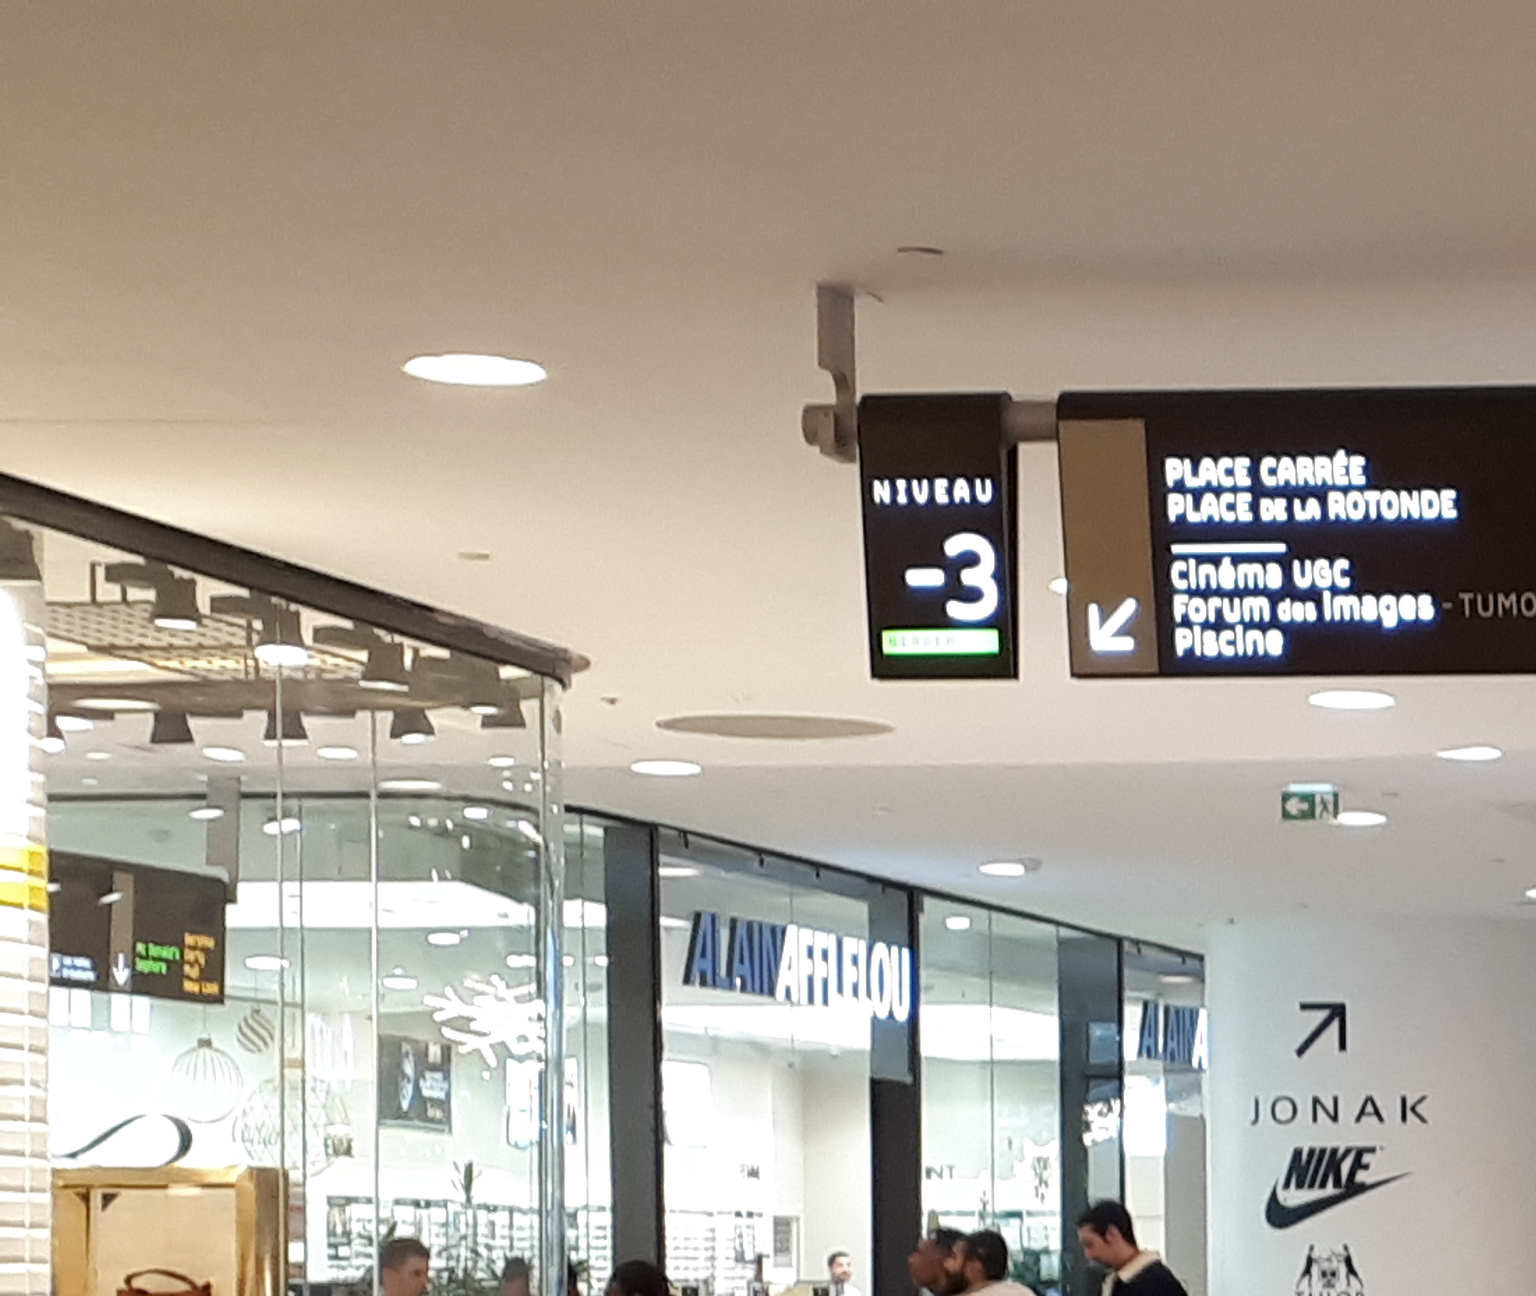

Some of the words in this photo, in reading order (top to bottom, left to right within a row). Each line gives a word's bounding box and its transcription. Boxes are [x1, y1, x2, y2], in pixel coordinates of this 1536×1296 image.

[1164, 456, 1252, 489] PLACE
[1259, 448, 1367, 488] CARRÉE
[873, 477, 993, 505] NIVEAU
[1167, 491, 1254, 523] PLACE
[1259, 497, 1288, 522] DE
[1293, 497, 1322, 522] LA
[1327, 489, 1458, 521] ROTONDE
[904, 532, 999, 623] -3
[1170, 555, 1283, 591] Cinéma
[1292, 558, 1351, 590] UGC
[1173, 593, 1271, 624] Forum
[1277, 597, 1318, 623] des
[1174, 625, 1284, 658] Piscine
[683, 910, 788, 996] ALAIN
[776, 922, 912, 1022] AFFLELOU
[1138, 1000, 1198, 1063] ALAIN
[1252, 1095, 1428, 1125] JONAK
[1280, 1145, 1378, 1192] NIKE
